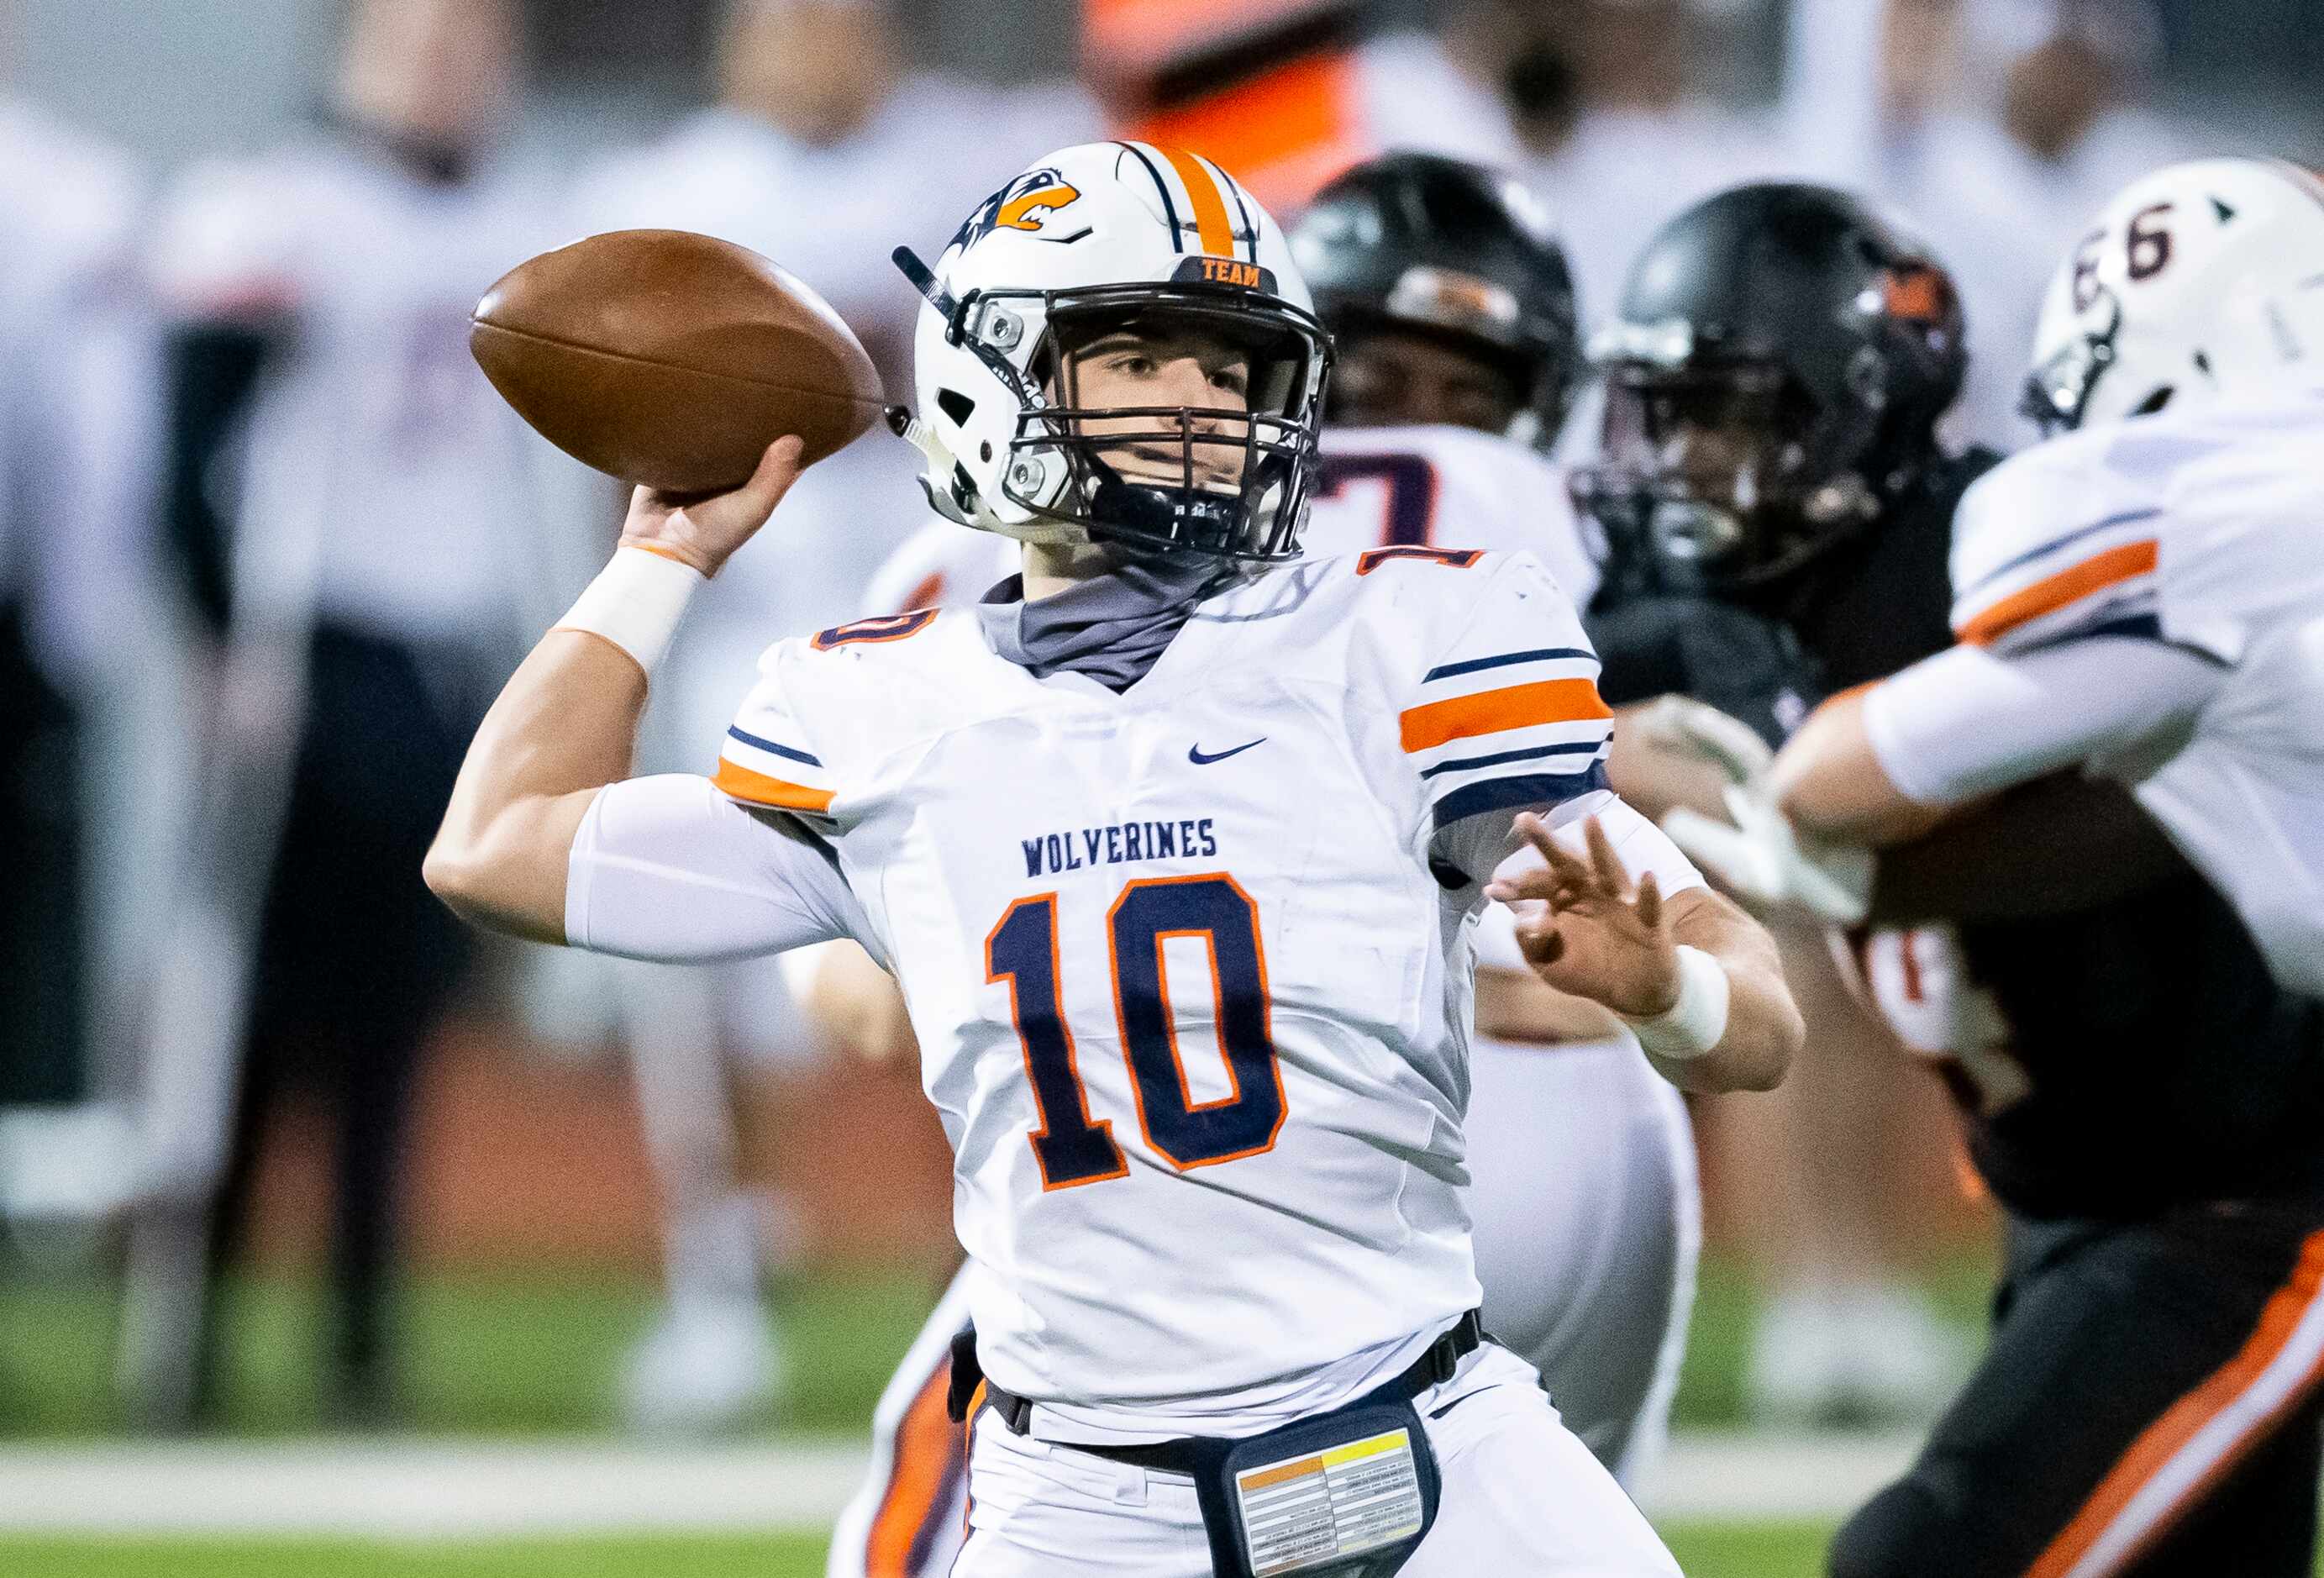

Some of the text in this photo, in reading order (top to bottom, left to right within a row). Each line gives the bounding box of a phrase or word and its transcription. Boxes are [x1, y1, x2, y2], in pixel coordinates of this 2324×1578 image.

[1202, 258, 1260, 288] TEAM
[1022, 818, 1217, 877] WOLVERINES
[985, 871, 1289, 1192] 10
